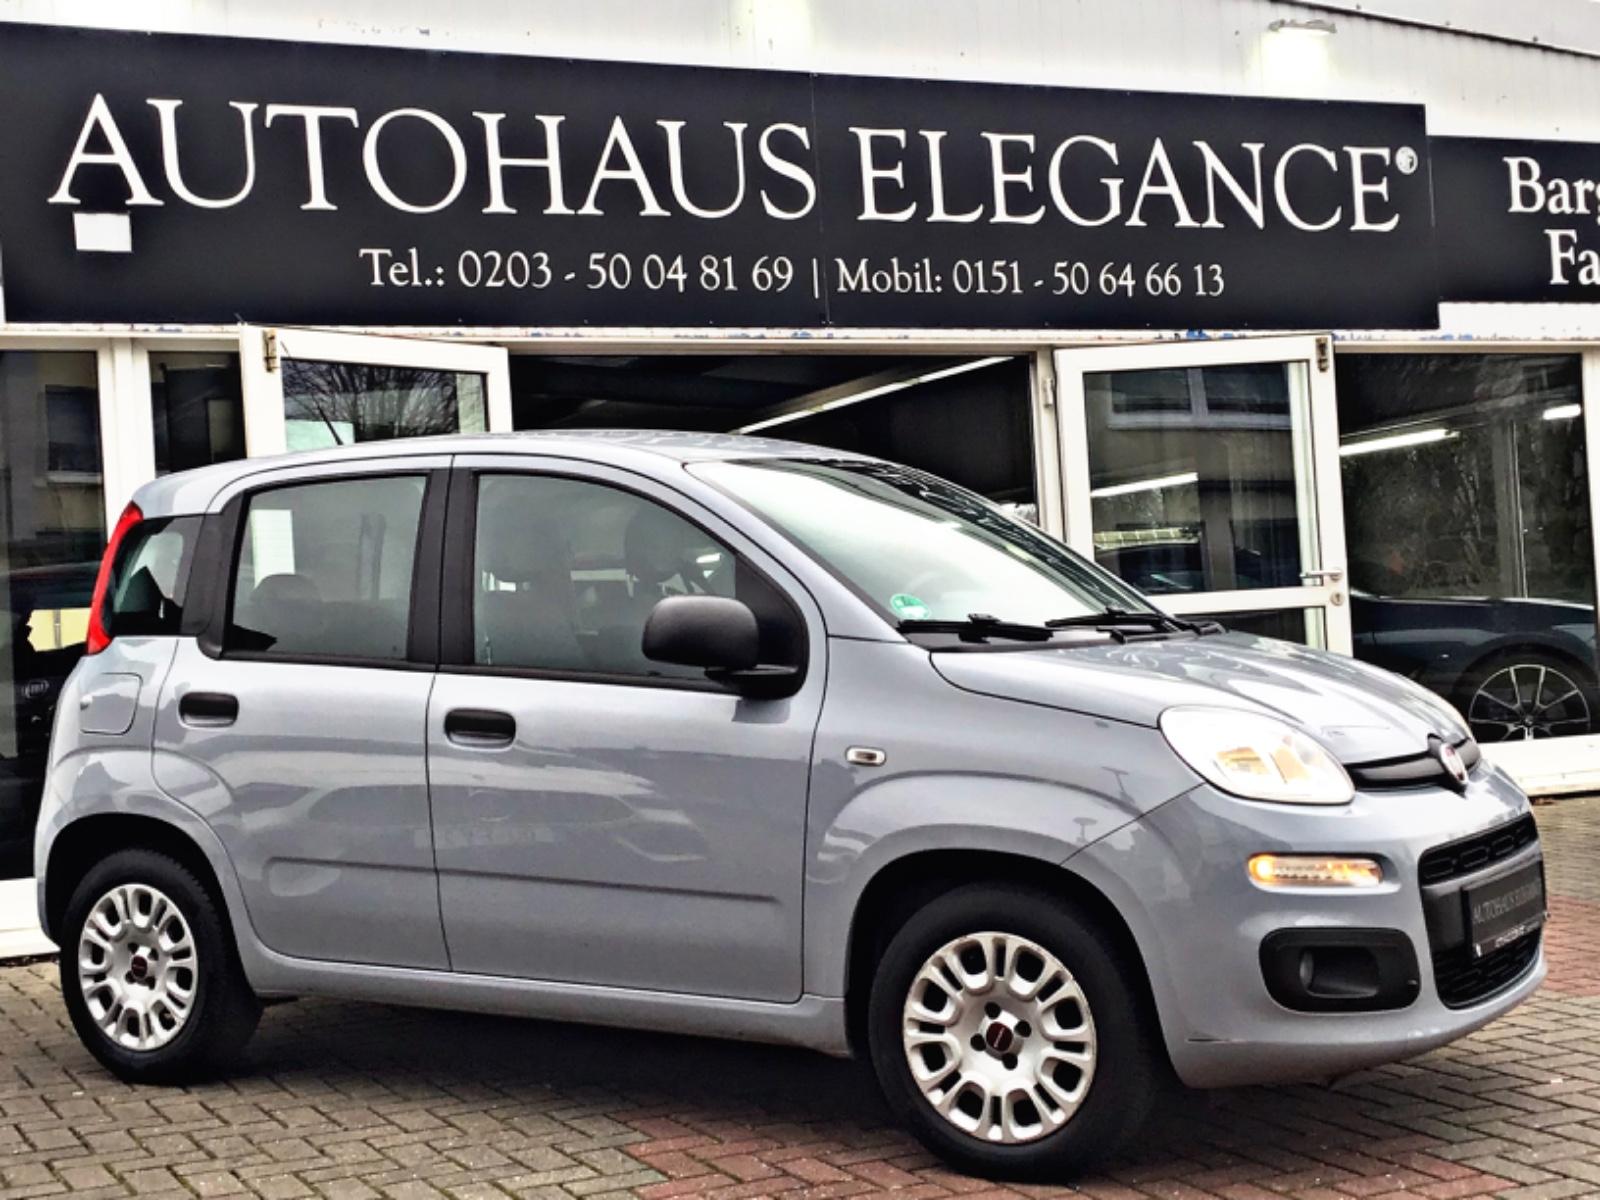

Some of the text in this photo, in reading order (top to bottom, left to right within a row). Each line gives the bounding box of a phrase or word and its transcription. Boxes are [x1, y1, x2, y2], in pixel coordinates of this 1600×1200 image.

[47, 92, 818, 221] AUTOHAUS
[1502, 156, 1600, 226] Bar
[358, 247, 446, 288] Tel.:
[457, 249, 552, 289] 0203
[587, 252, 632, 290] 50
[642, 253, 688, 293] 04
[699, 254, 738, 291] 81
[751, 255, 794, 292] 69
[834, 256, 943, 294] Mobil:
[952, 259, 1024, 294] 0151
[1052, 260, 1090, 295] 50
[1098, 261, 1136, 298] 64
[1145, 262, 1182, 297] 66
[1193, 263, 1225, 297] 13
